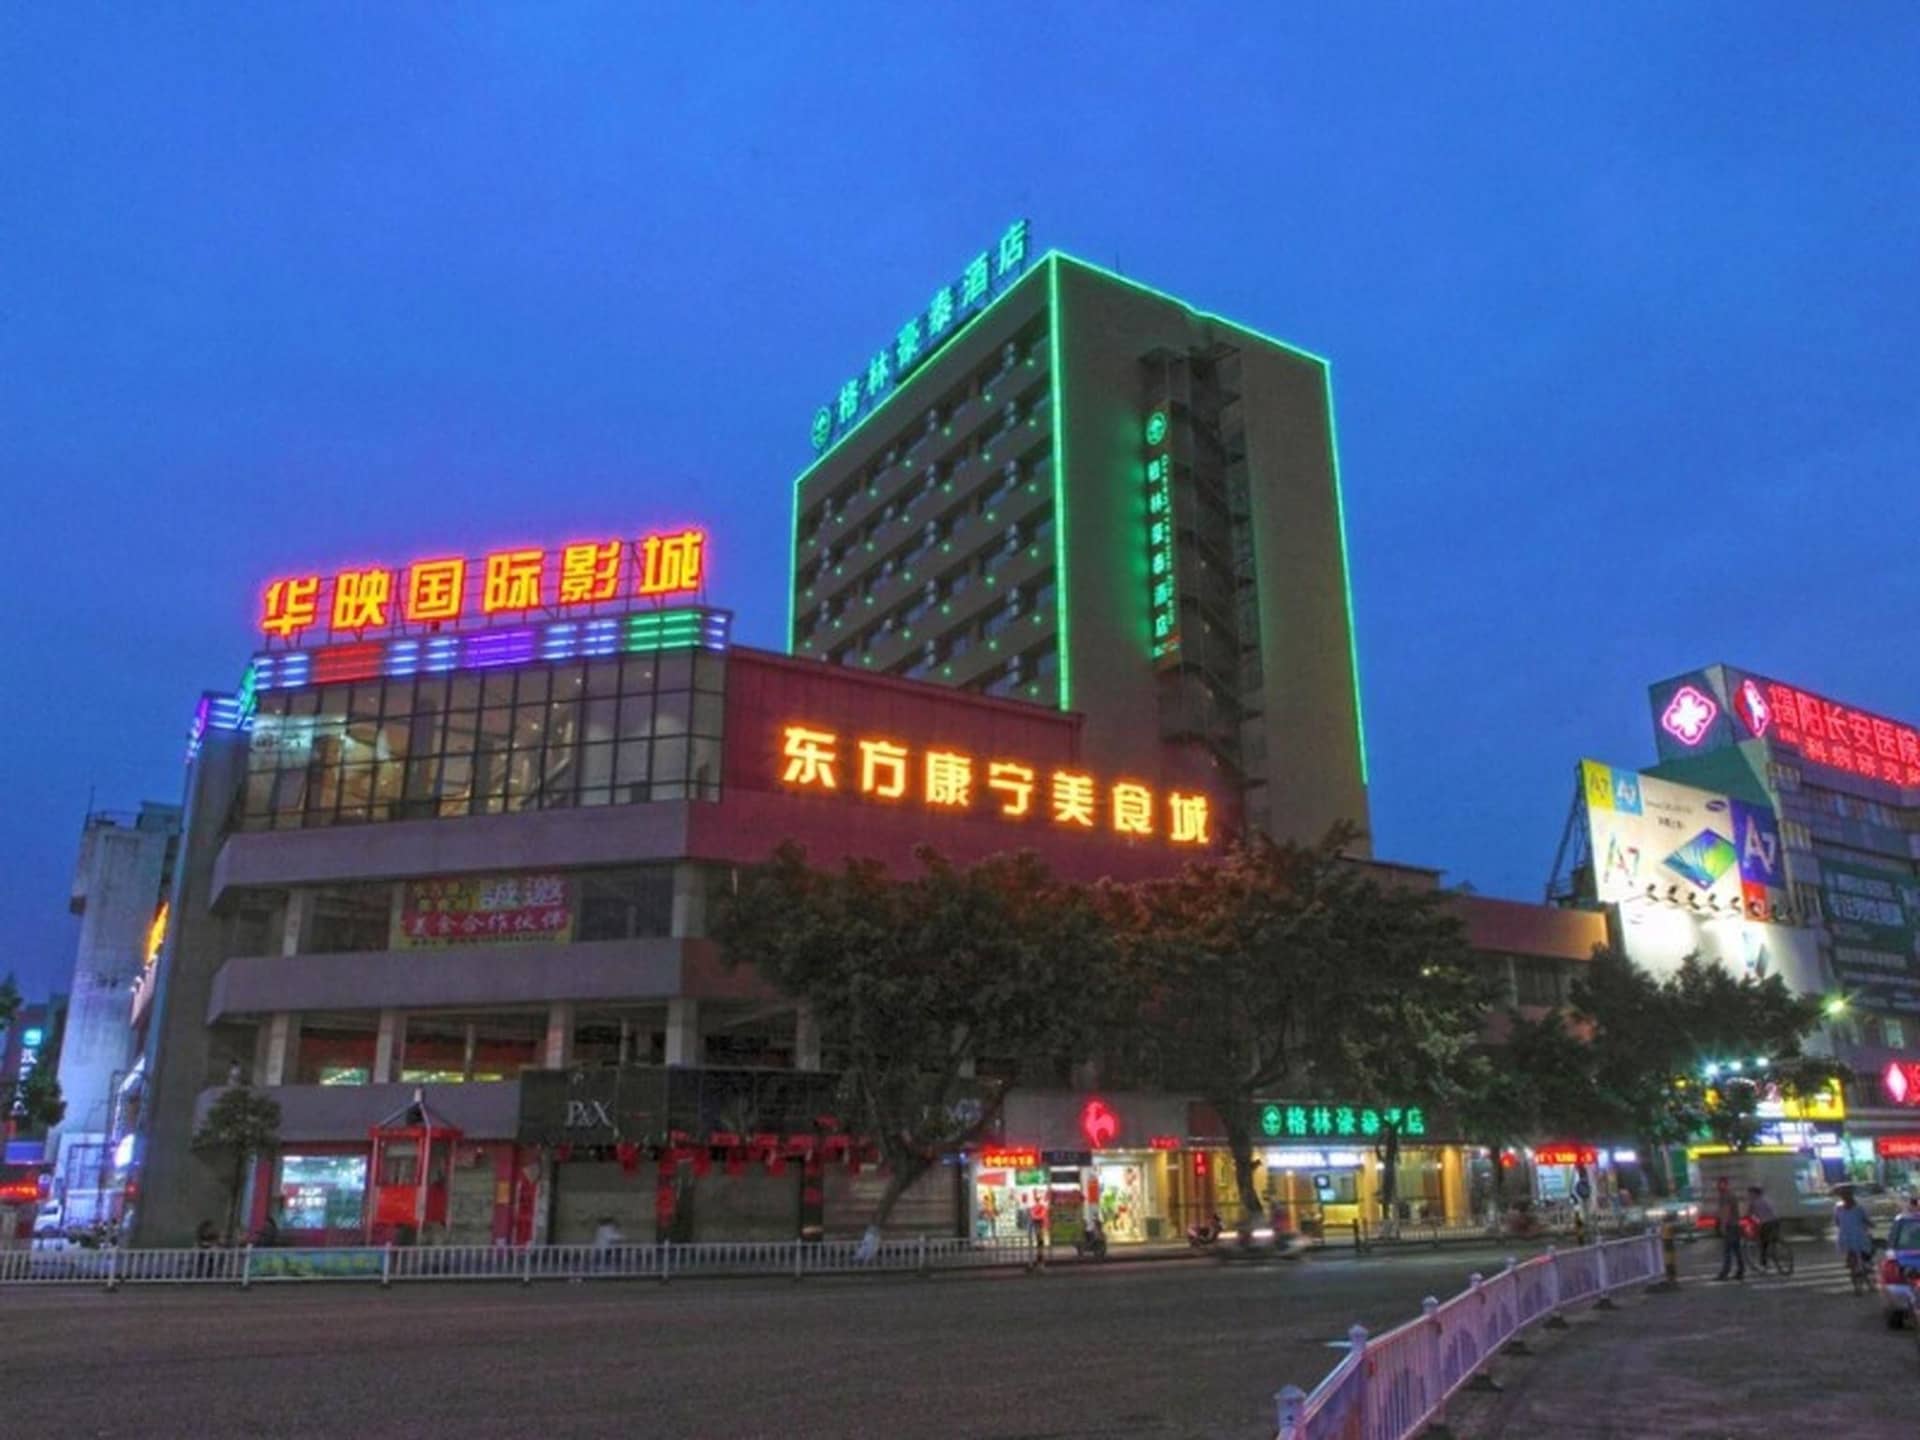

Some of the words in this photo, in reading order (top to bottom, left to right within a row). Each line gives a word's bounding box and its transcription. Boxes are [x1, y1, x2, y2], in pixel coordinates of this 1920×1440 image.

[836, 219, 1029, 424] 格林豪泰酒店
[262, 529, 705, 637] 华映国际影城
[1768, 685, 1920, 767] 揭阳长安医院
[783, 726, 1211, 845] 东方康宁美食城
[1743, 815, 1776, 875] A7
